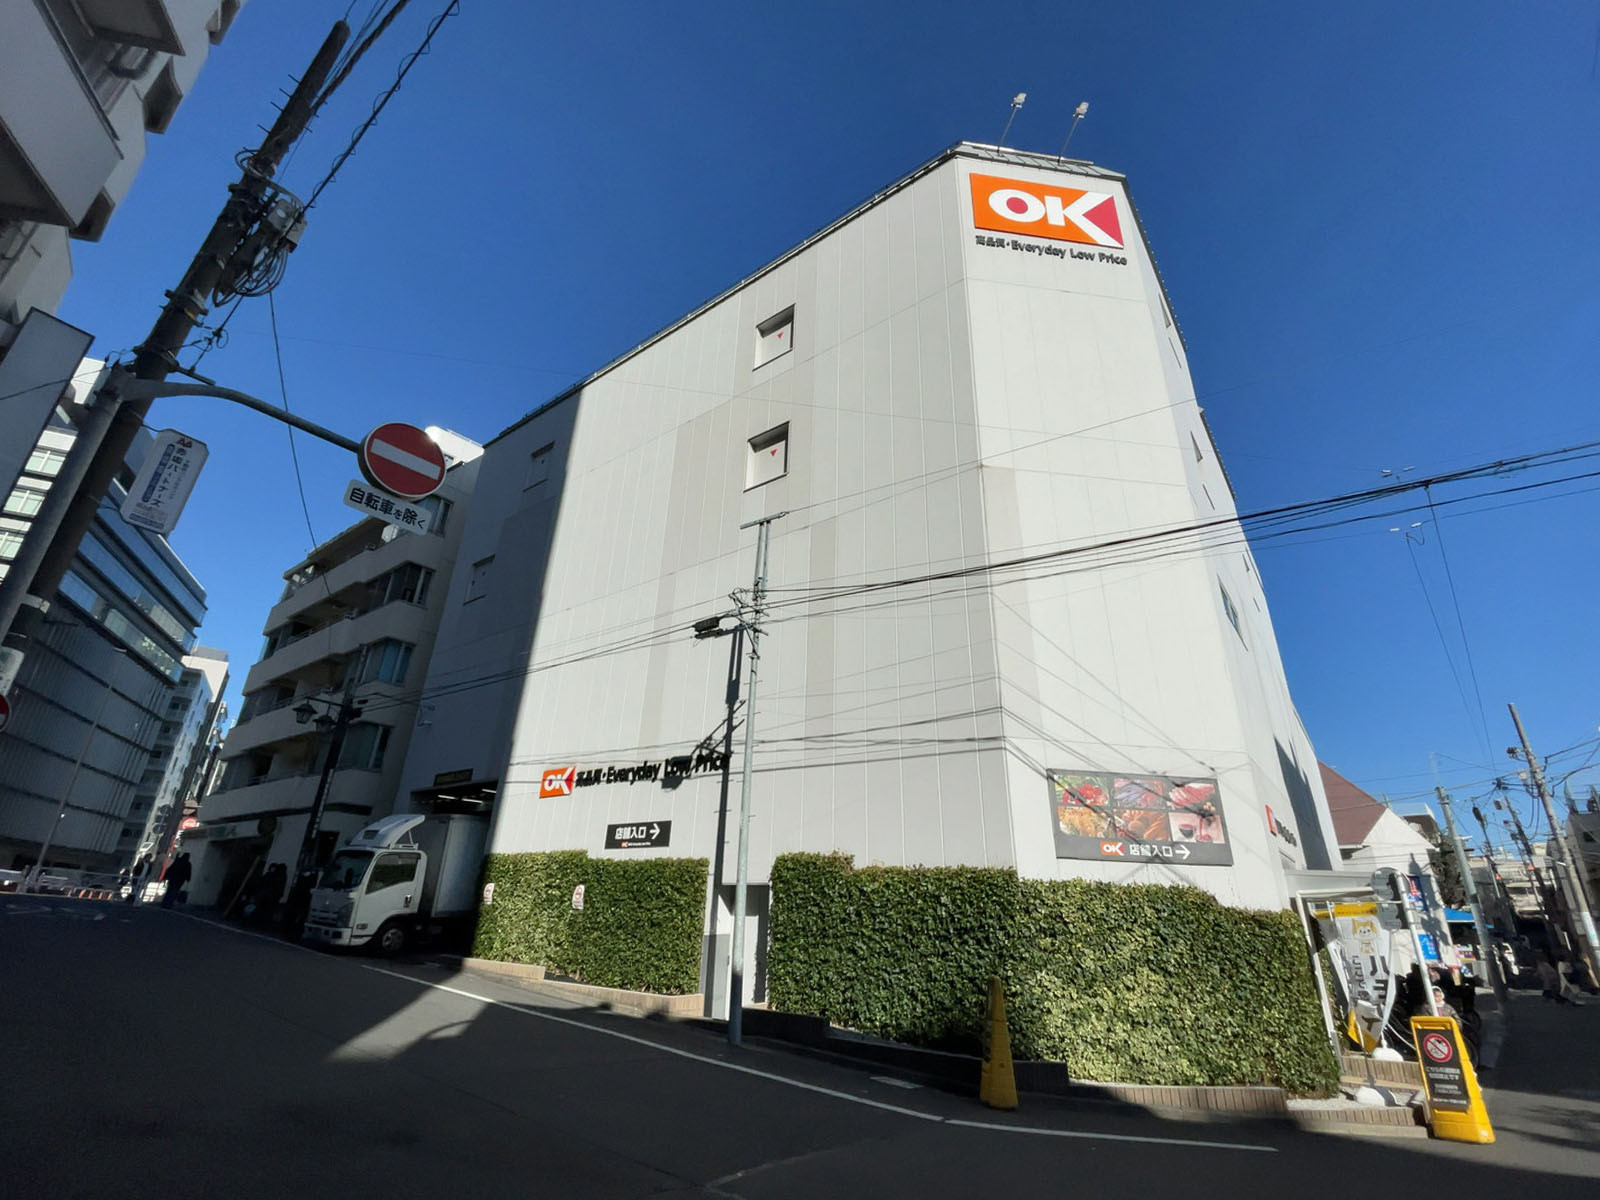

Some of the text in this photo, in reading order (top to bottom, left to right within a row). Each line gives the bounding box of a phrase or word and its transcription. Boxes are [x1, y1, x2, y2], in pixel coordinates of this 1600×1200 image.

[988, 189, 1124, 248] OK
[1070, 248, 1095, 261] Low
[1098, 252, 1128, 266] Price
[349, 487, 426, 530] 自転車を除く
[544, 767, 573, 795] OK
[1103, 842, 1124, 856] OK
